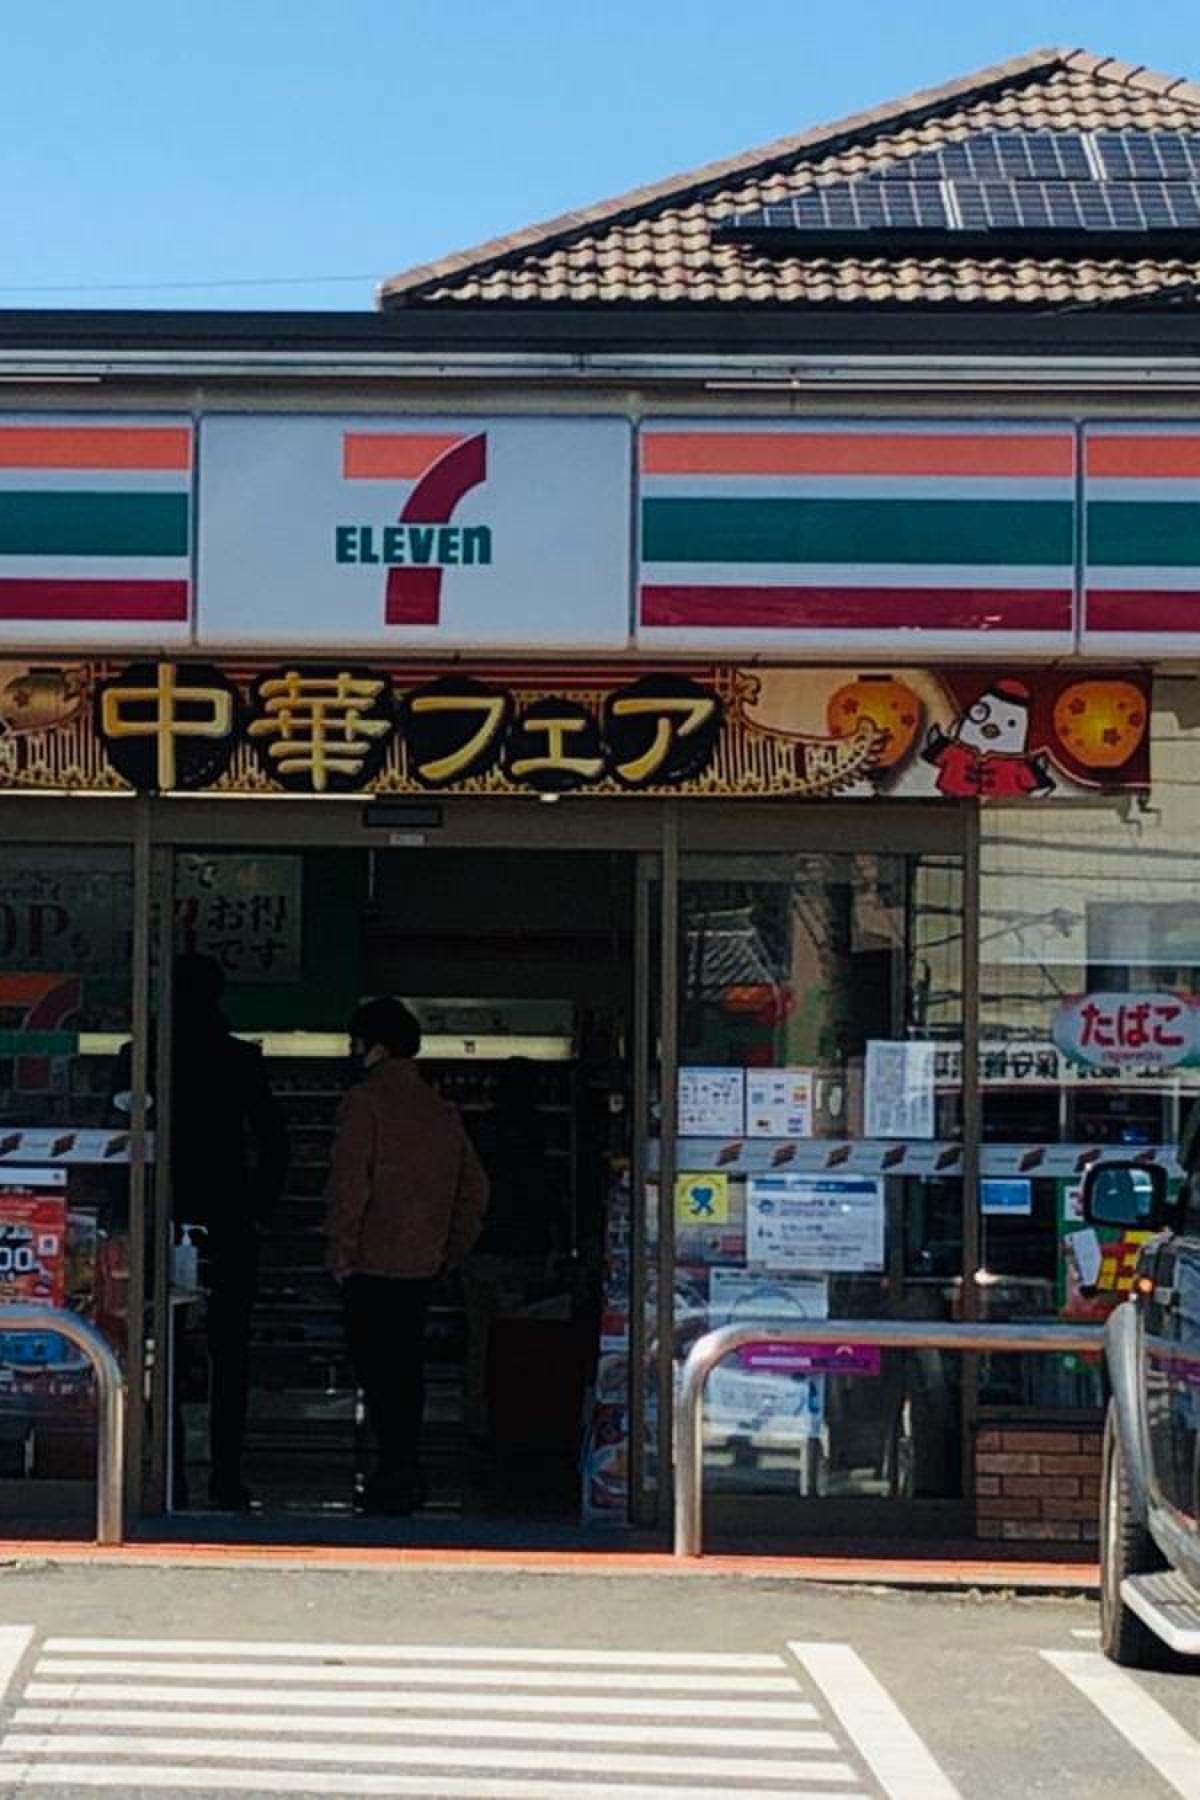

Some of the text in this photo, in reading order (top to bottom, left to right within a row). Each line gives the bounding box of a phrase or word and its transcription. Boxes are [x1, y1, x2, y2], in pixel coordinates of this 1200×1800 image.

[101, 662, 715, 791] 中華フェア
[1081, 1003, 1184, 1047] たばこ
